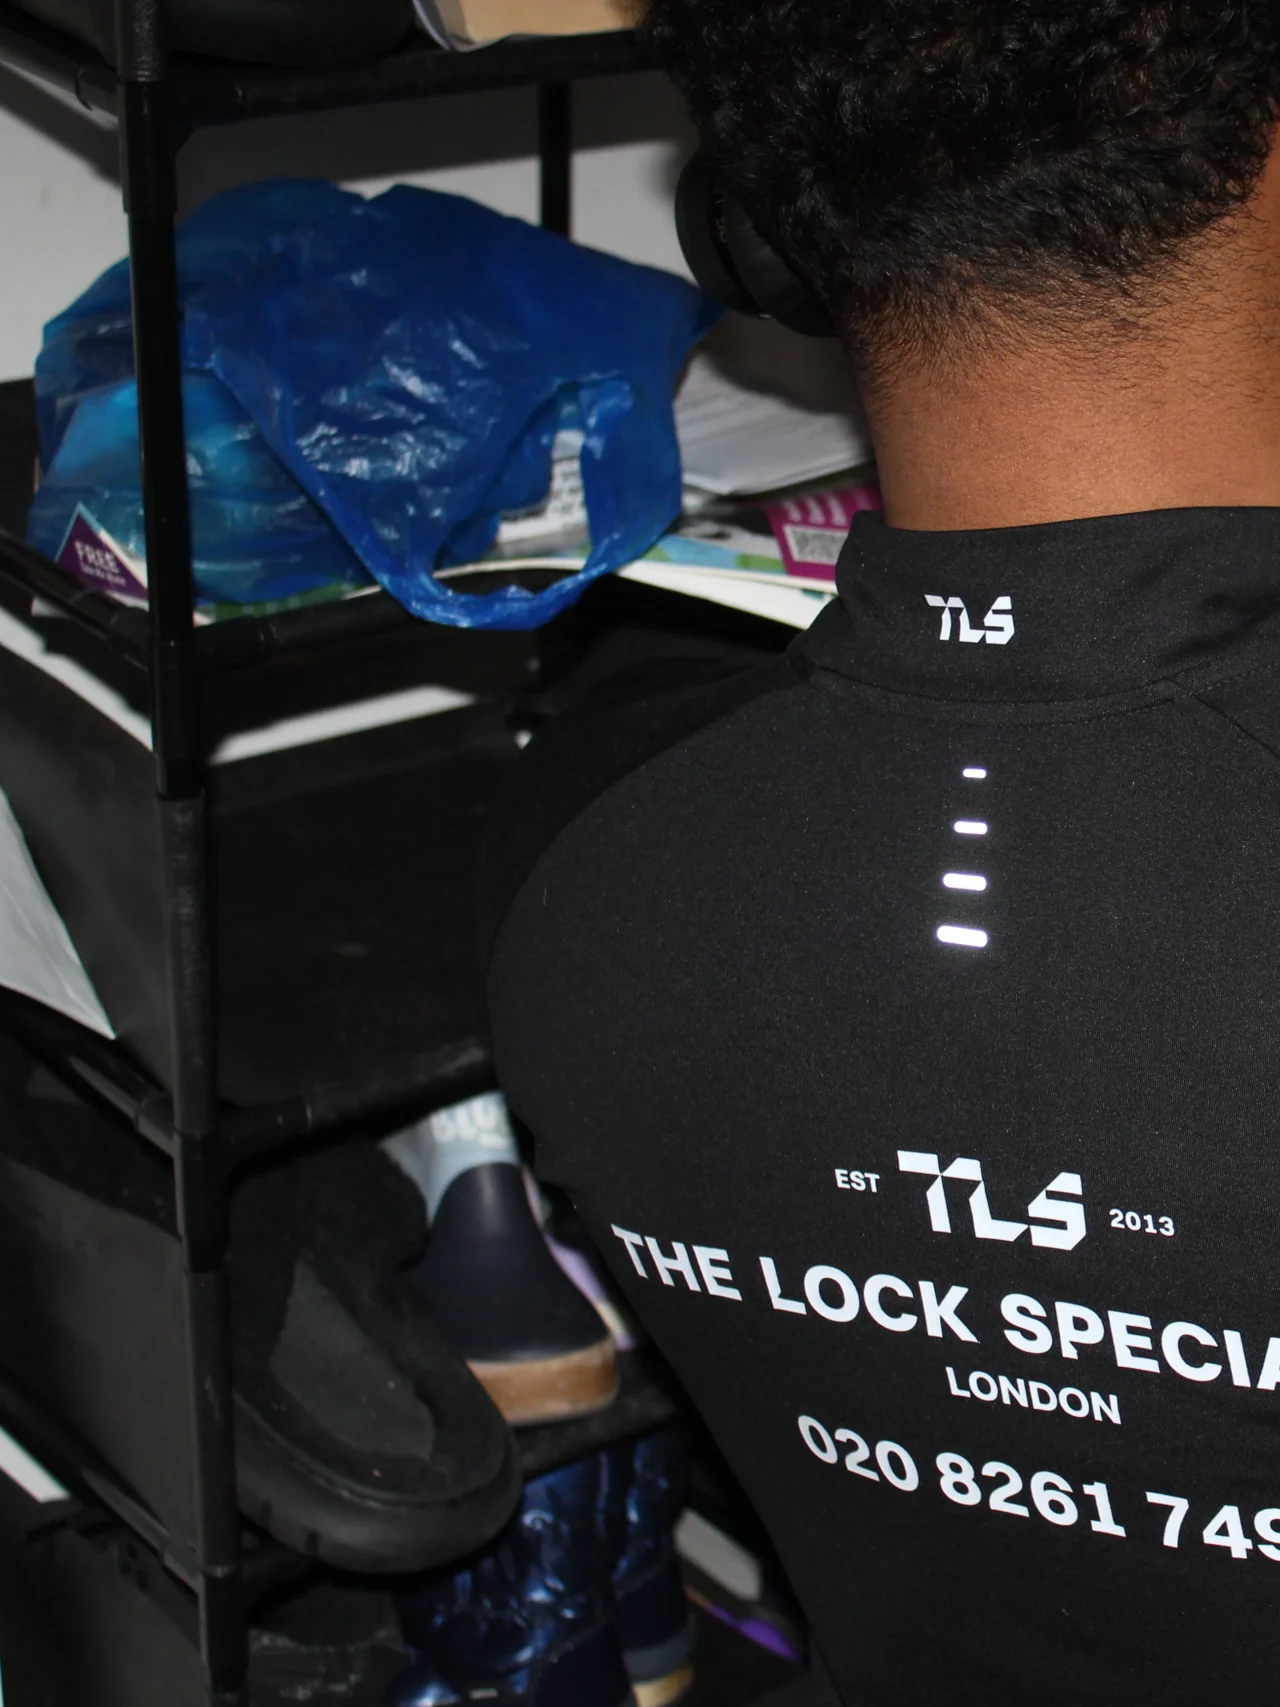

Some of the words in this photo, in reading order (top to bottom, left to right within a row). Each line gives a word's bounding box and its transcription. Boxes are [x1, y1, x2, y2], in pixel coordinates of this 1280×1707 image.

[924, 594, 1015, 645] TLS
[834, 1168, 881, 1193] EST
[896, 1149, 1087, 1251] TLS
[1108, 1208, 1175, 1237] 2013
[611, 1224, 743, 1301] THE
[758, 1256, 979, 1343] LOCK
[945, 1366, 1122, 1425] LONDON
[797, 1415, 919, 1492] 020
[935, 1452, 1127, 1538] 8261
